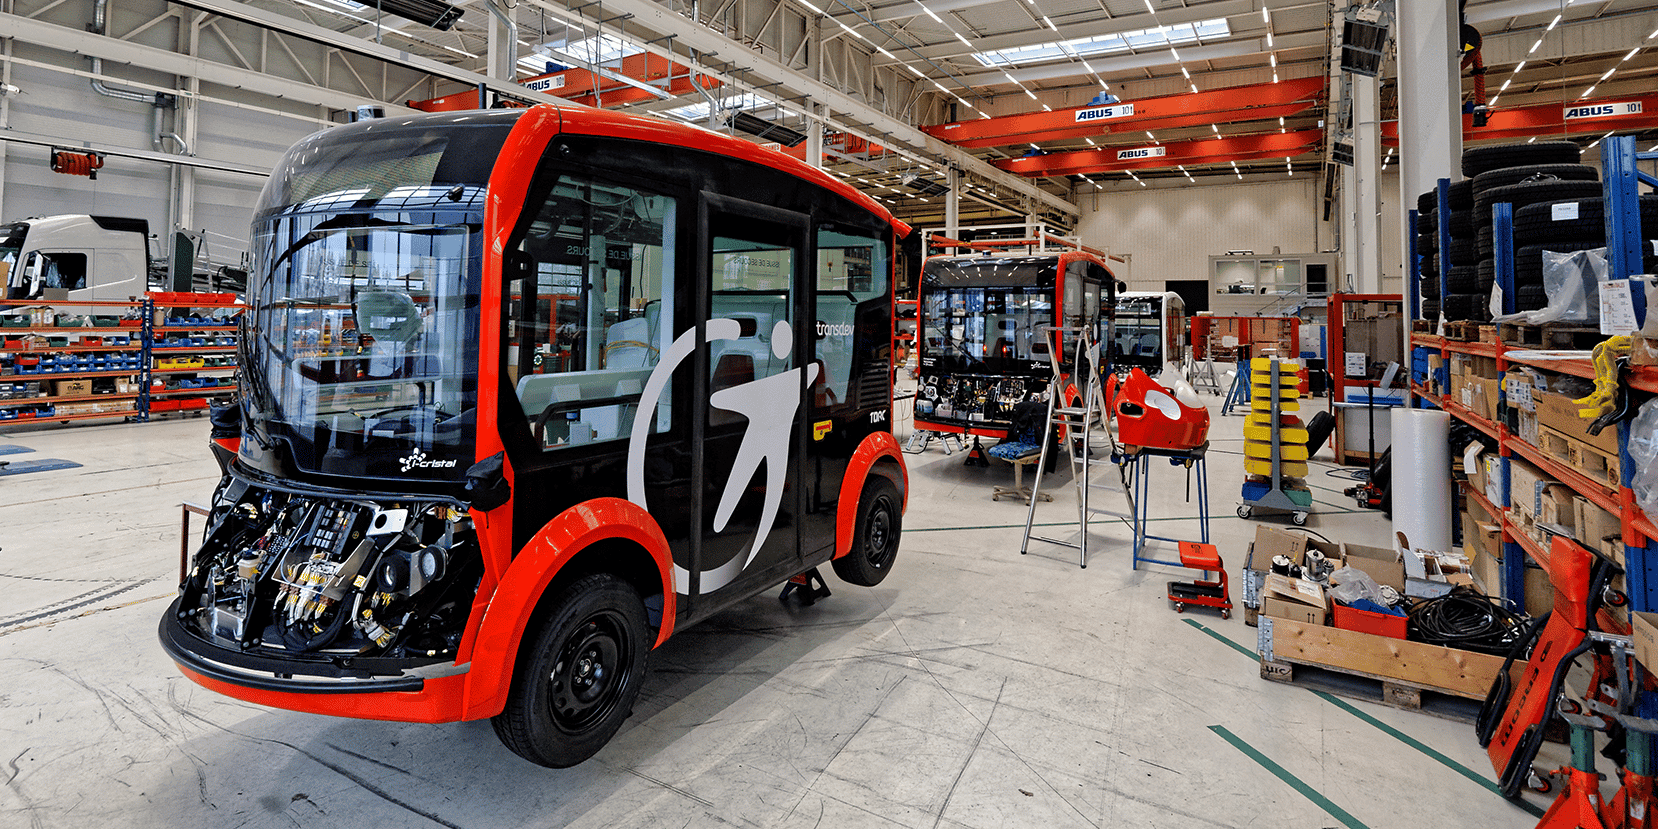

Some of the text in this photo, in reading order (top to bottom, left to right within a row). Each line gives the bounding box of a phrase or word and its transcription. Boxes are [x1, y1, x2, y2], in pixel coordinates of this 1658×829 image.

[526, 79, 550, 91] ABUS
[1077, 108, 1113, 120] ABUS
[1566, 105, 1613, 118] ABUS
[1118, 149, 1148, 159] ABUS
[816, 321, 855, 336] transdev
